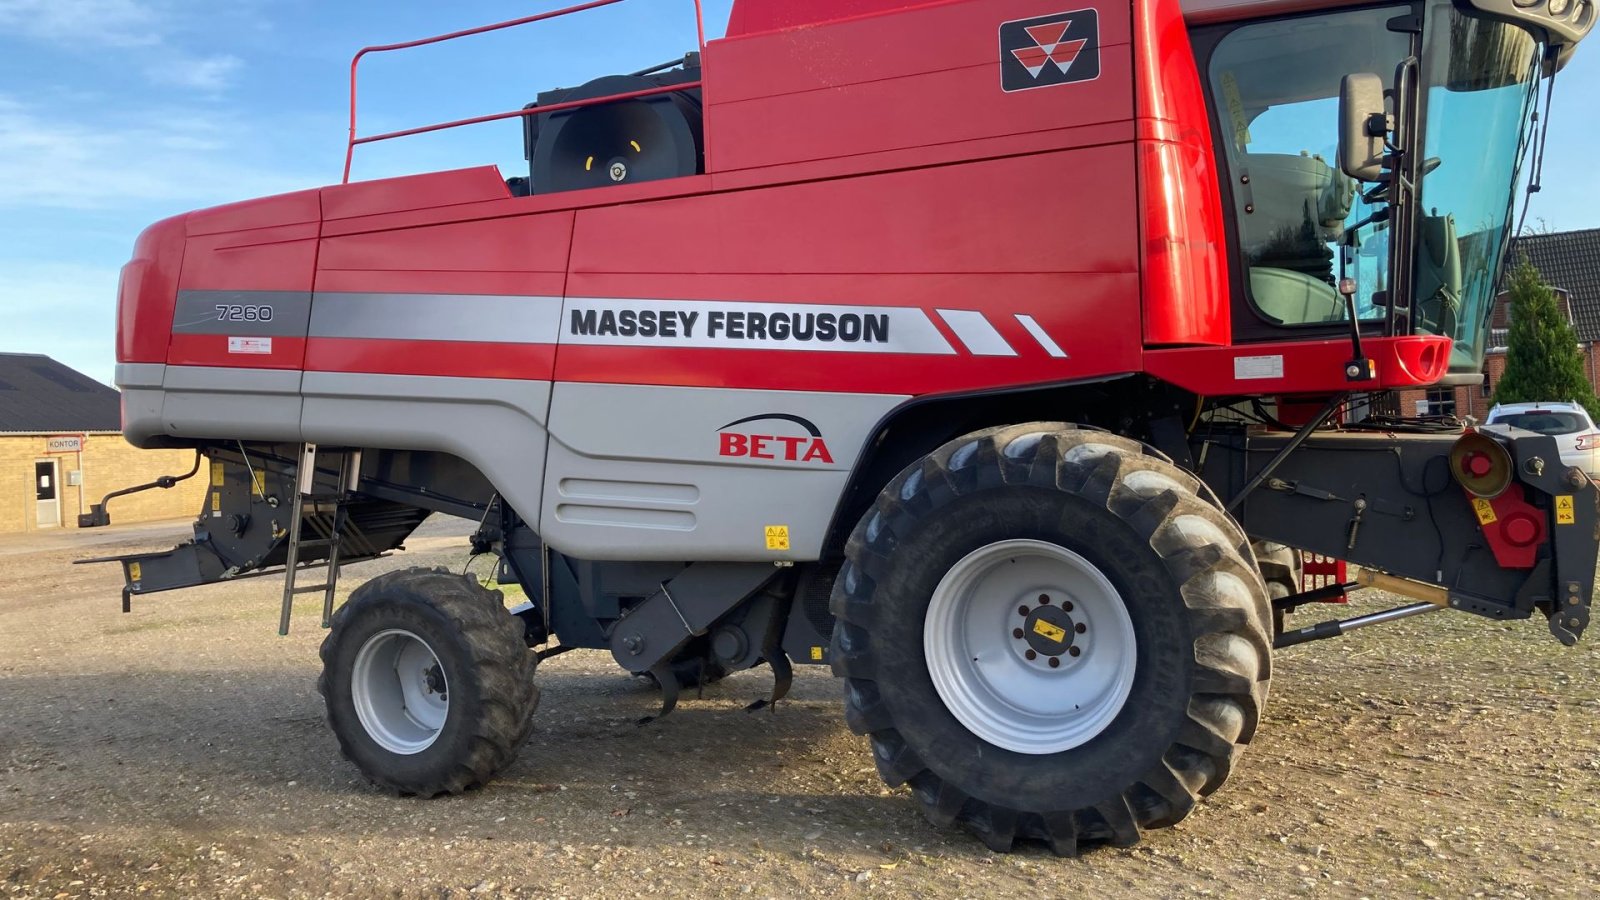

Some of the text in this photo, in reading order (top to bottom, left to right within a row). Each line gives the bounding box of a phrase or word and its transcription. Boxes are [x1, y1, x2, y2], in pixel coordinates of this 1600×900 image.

[215, 304, 274, 322] 7260
[571, 309, 889, 343] MASSEY FERGUSON
[50, 440, 79, 448] KONTOR
[719, 432, 834, 464] BETA
